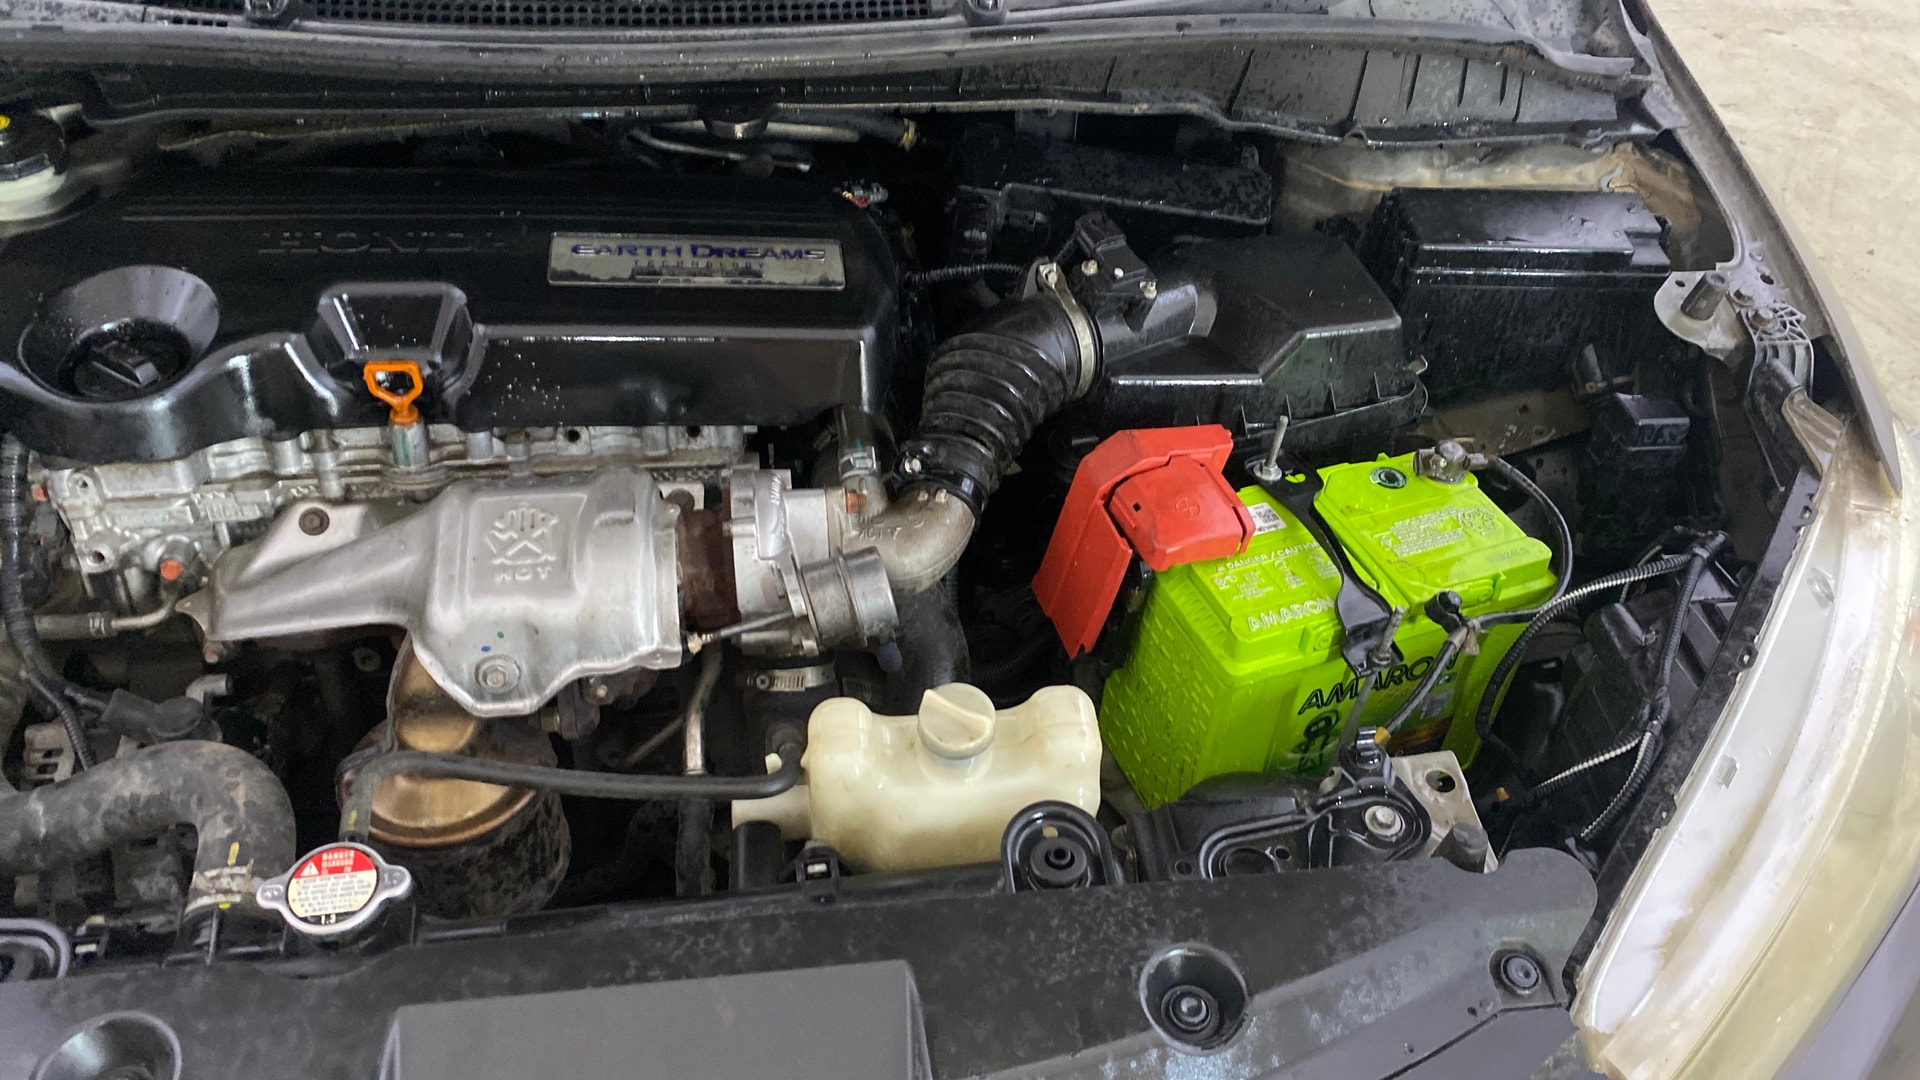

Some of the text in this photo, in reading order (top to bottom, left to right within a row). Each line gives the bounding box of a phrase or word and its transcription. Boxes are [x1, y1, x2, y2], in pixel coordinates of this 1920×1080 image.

[571, 243, 825, 261] EARTH DREAMS
[1226, 552, 1269, 570] DANGER
[1277, 541, 1321, 558] CAUTION
[1247, 595, 1336, 632] AMARON
